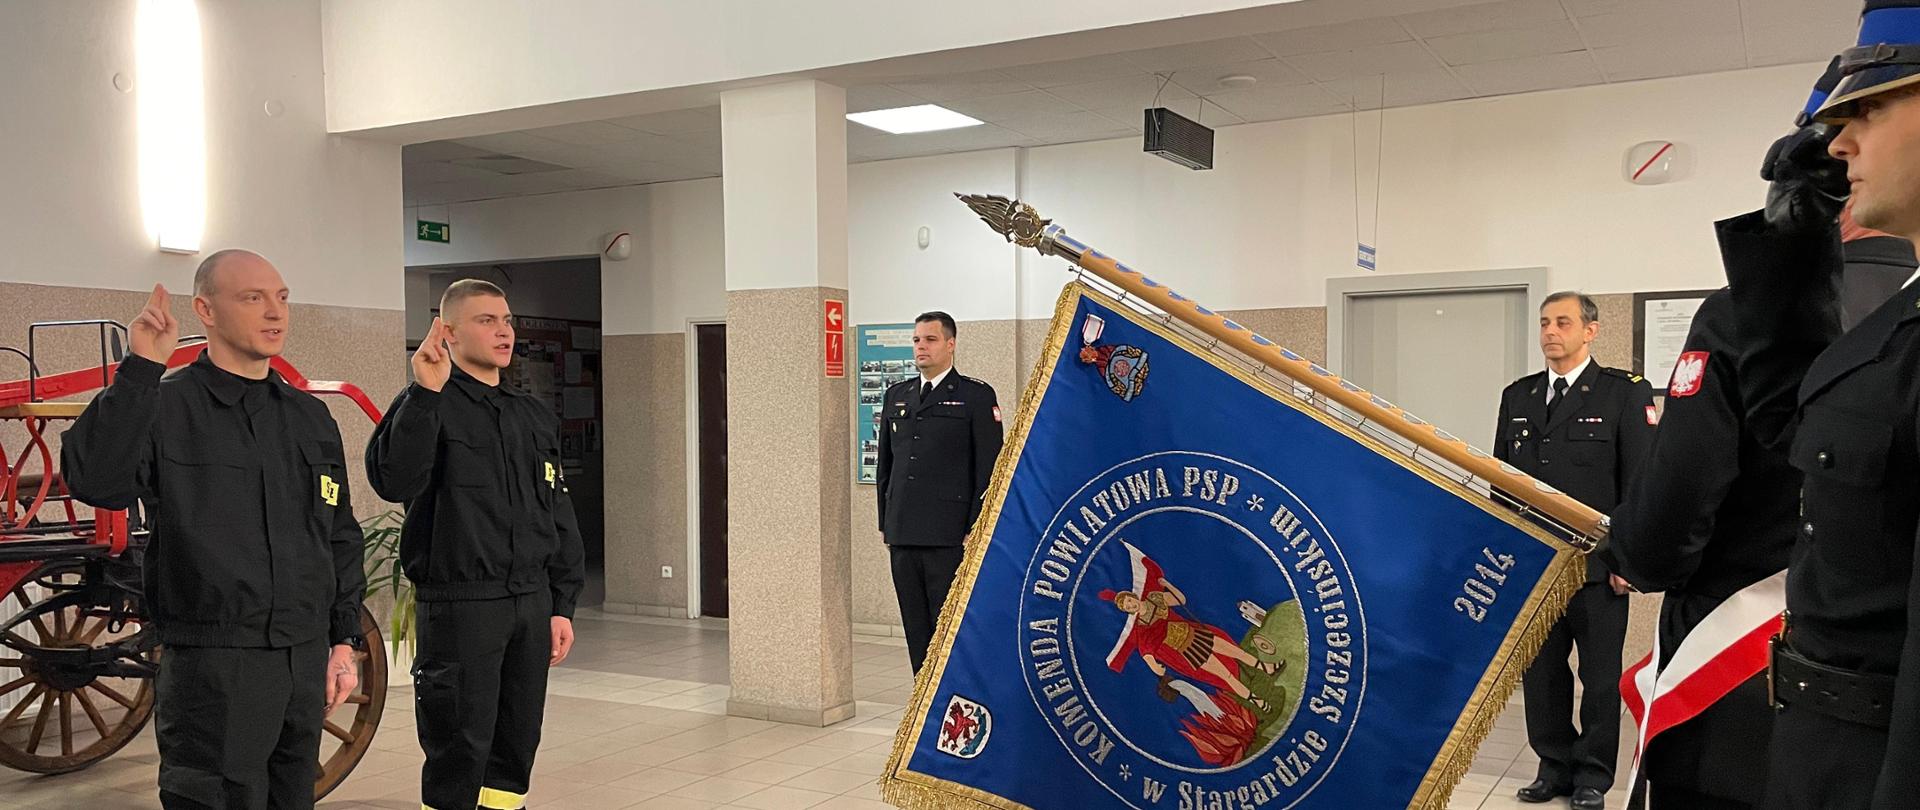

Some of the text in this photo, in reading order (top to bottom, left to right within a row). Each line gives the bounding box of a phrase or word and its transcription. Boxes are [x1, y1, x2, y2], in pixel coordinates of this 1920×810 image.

[1029, 466, 1239, 766] KOMENDA POWIATOWA PSP
[1143, 504, 1352, 810] w Stargardzie Szczecińskim
[1453, 546, 1516, 623] 2014
